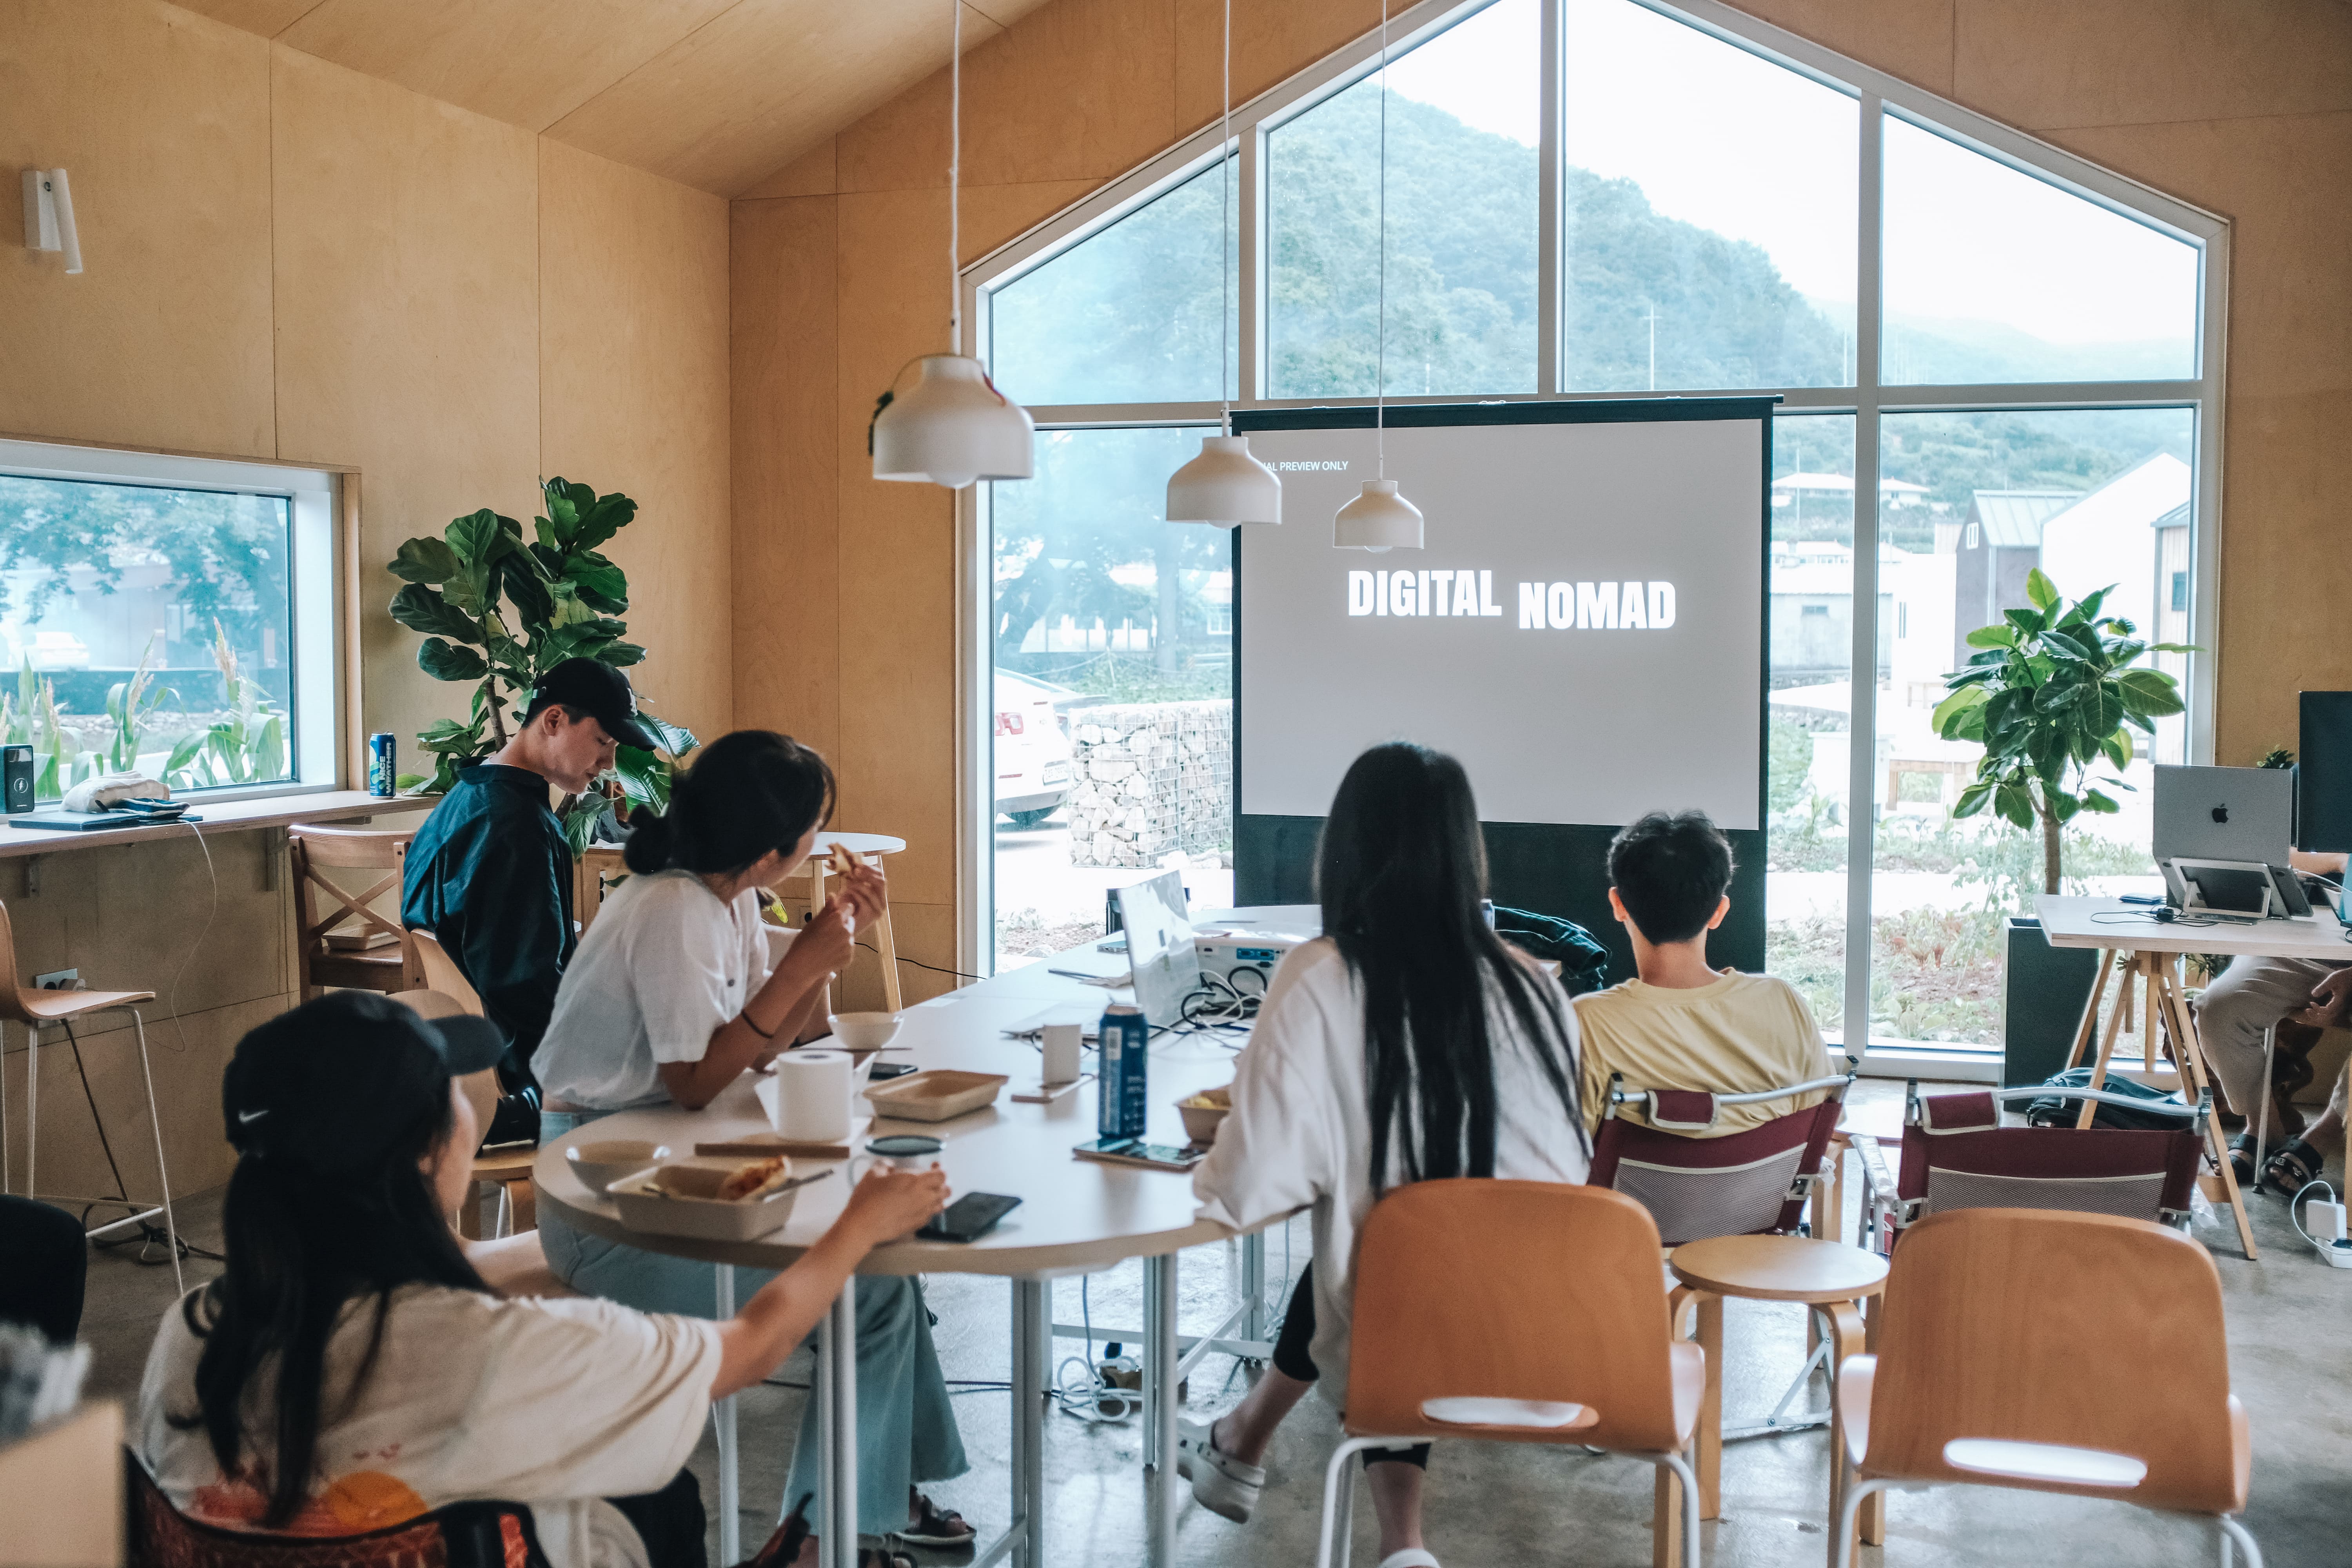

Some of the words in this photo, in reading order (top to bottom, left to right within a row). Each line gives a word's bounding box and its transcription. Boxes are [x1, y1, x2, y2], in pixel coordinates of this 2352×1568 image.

[1280, 461, 1320, 471] PREVIEW
[1322, 461, 1348, 470] ONLY
[1348, 570, 1502, 616] DIGITAL
[1519, 581, 1676, 629] NOMAD
